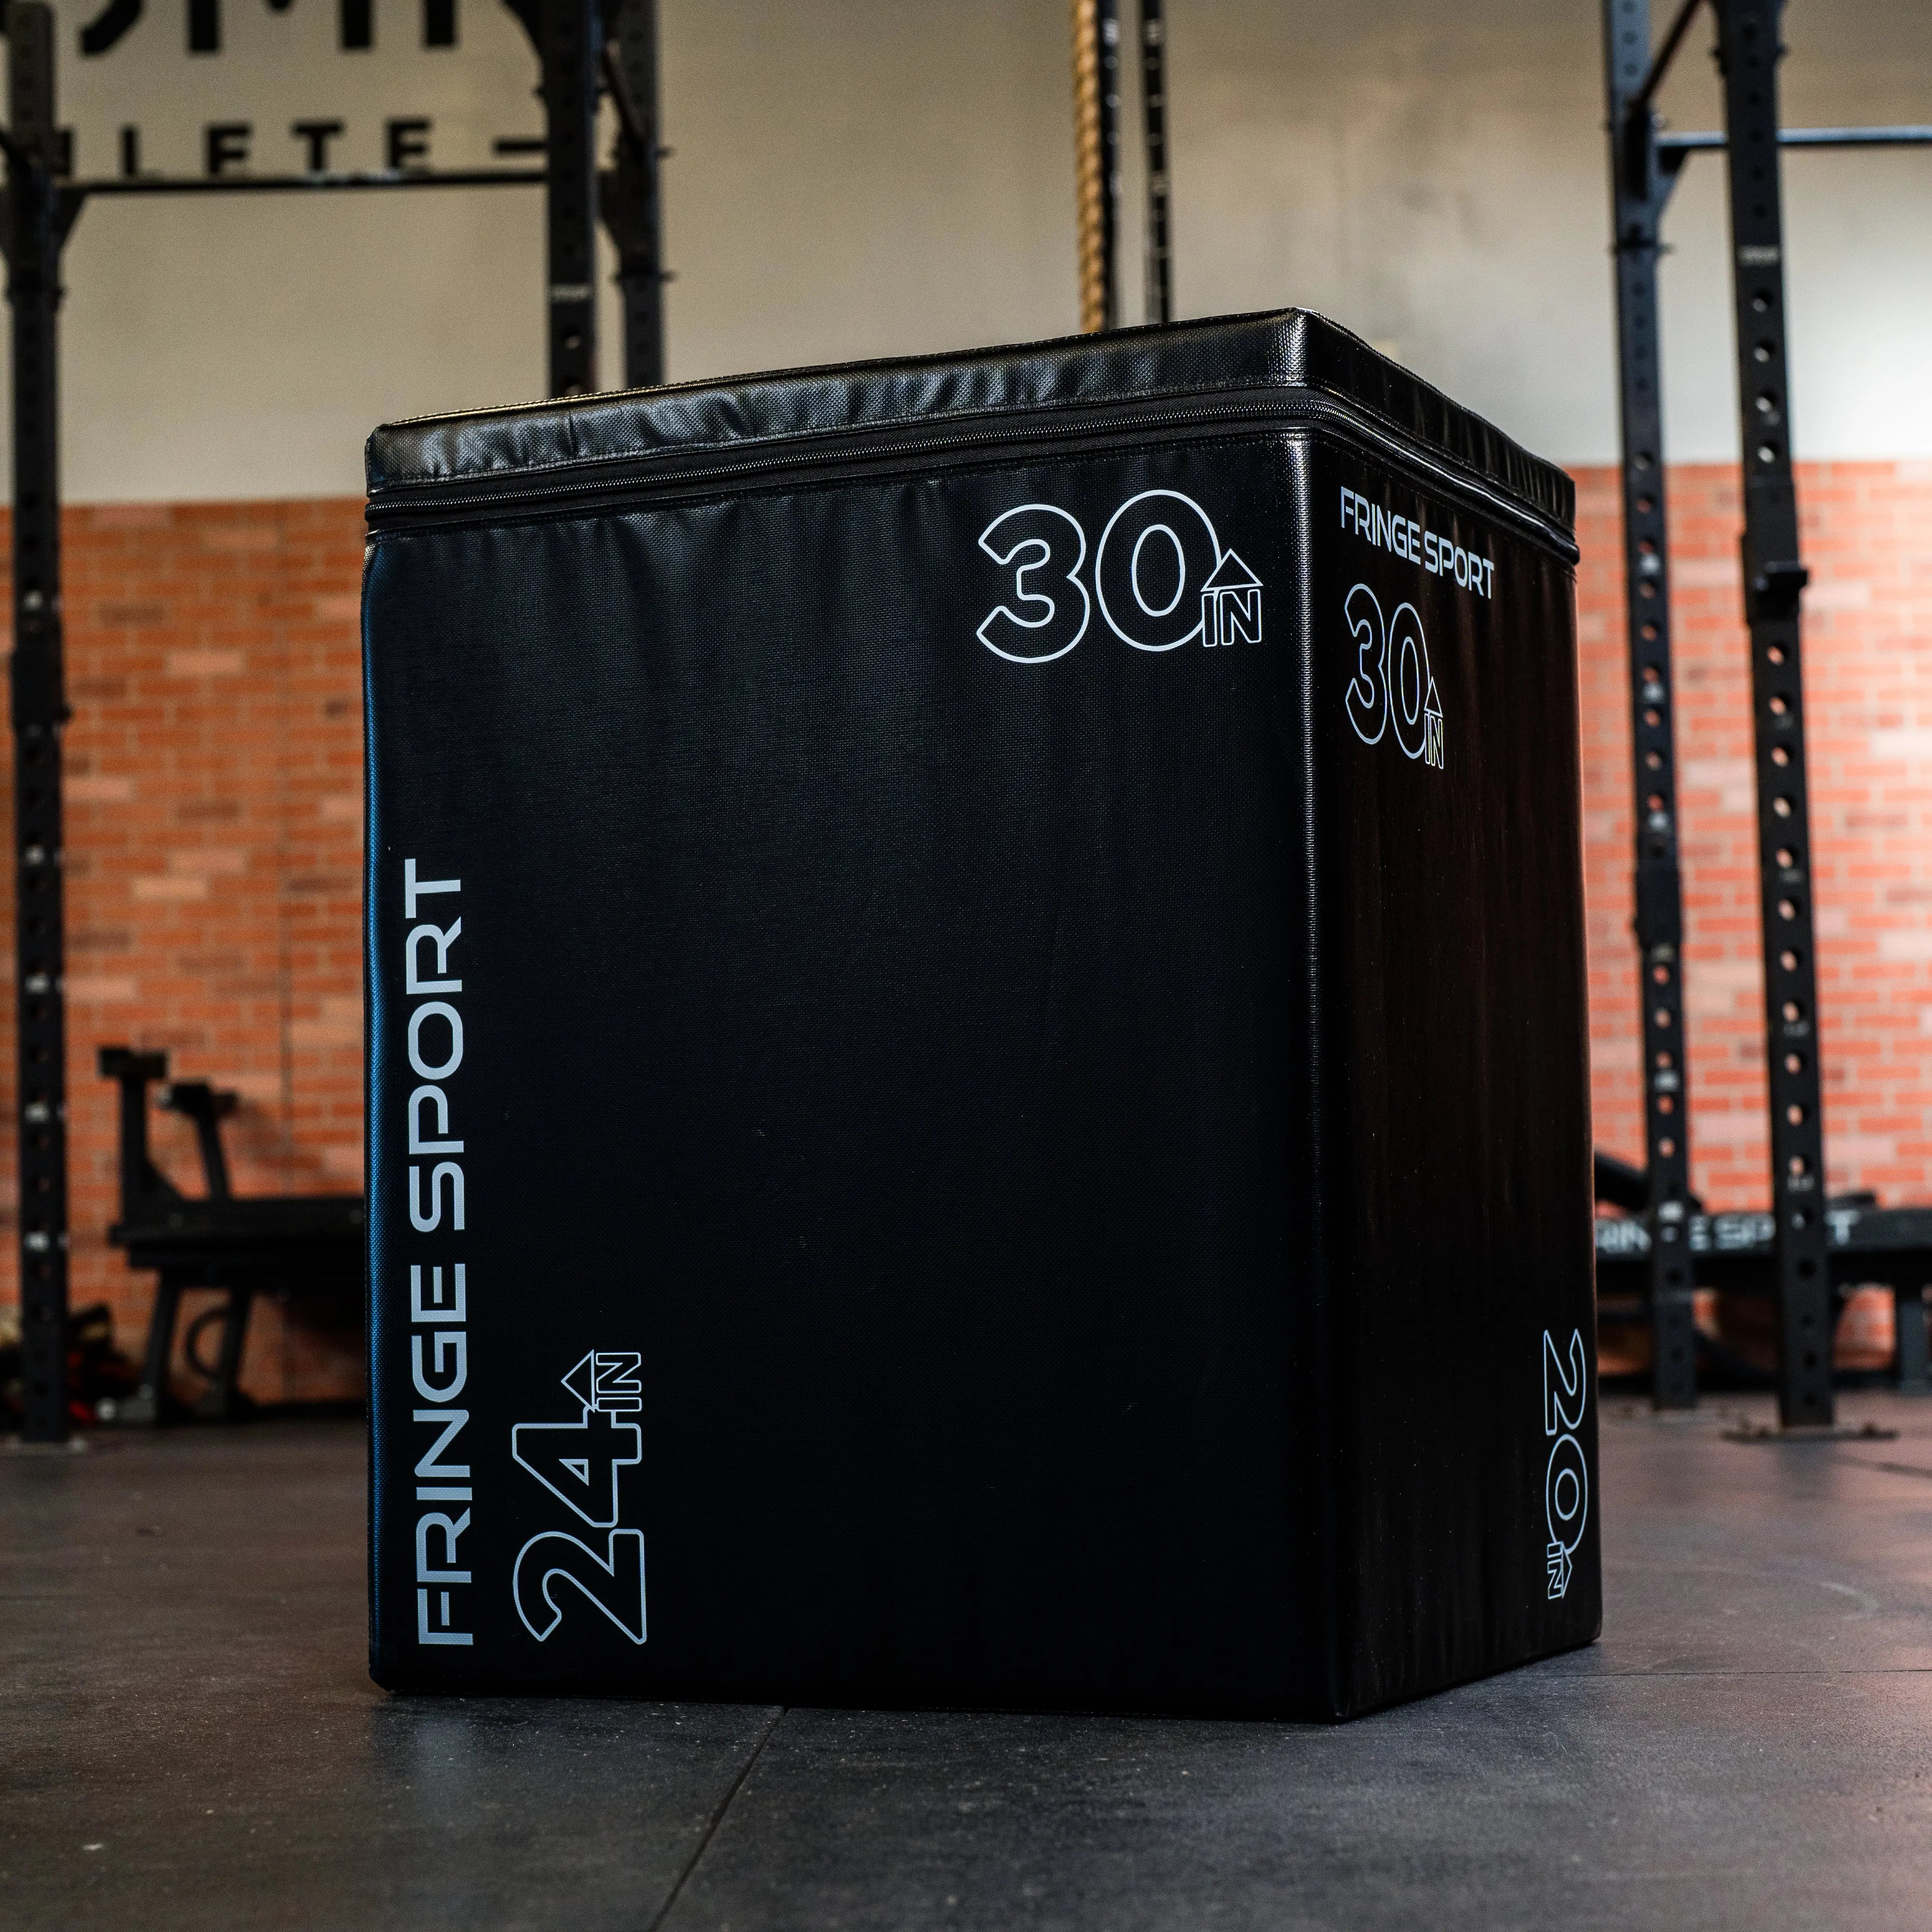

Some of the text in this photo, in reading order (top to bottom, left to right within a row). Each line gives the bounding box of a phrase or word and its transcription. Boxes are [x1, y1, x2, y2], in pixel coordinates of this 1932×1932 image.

[976, 489, 1261, 663] 30 IN
[1341, 486, 1494, 599] FRINGE SPORT
[1344, 583, 1444, 770] 30 IN
[404, 858, 473, 1645] FRINGE SPORT
[512, 1351, 647, 1645] 24 IN
[1543, 1328, 1588, 1600] 20 IN
